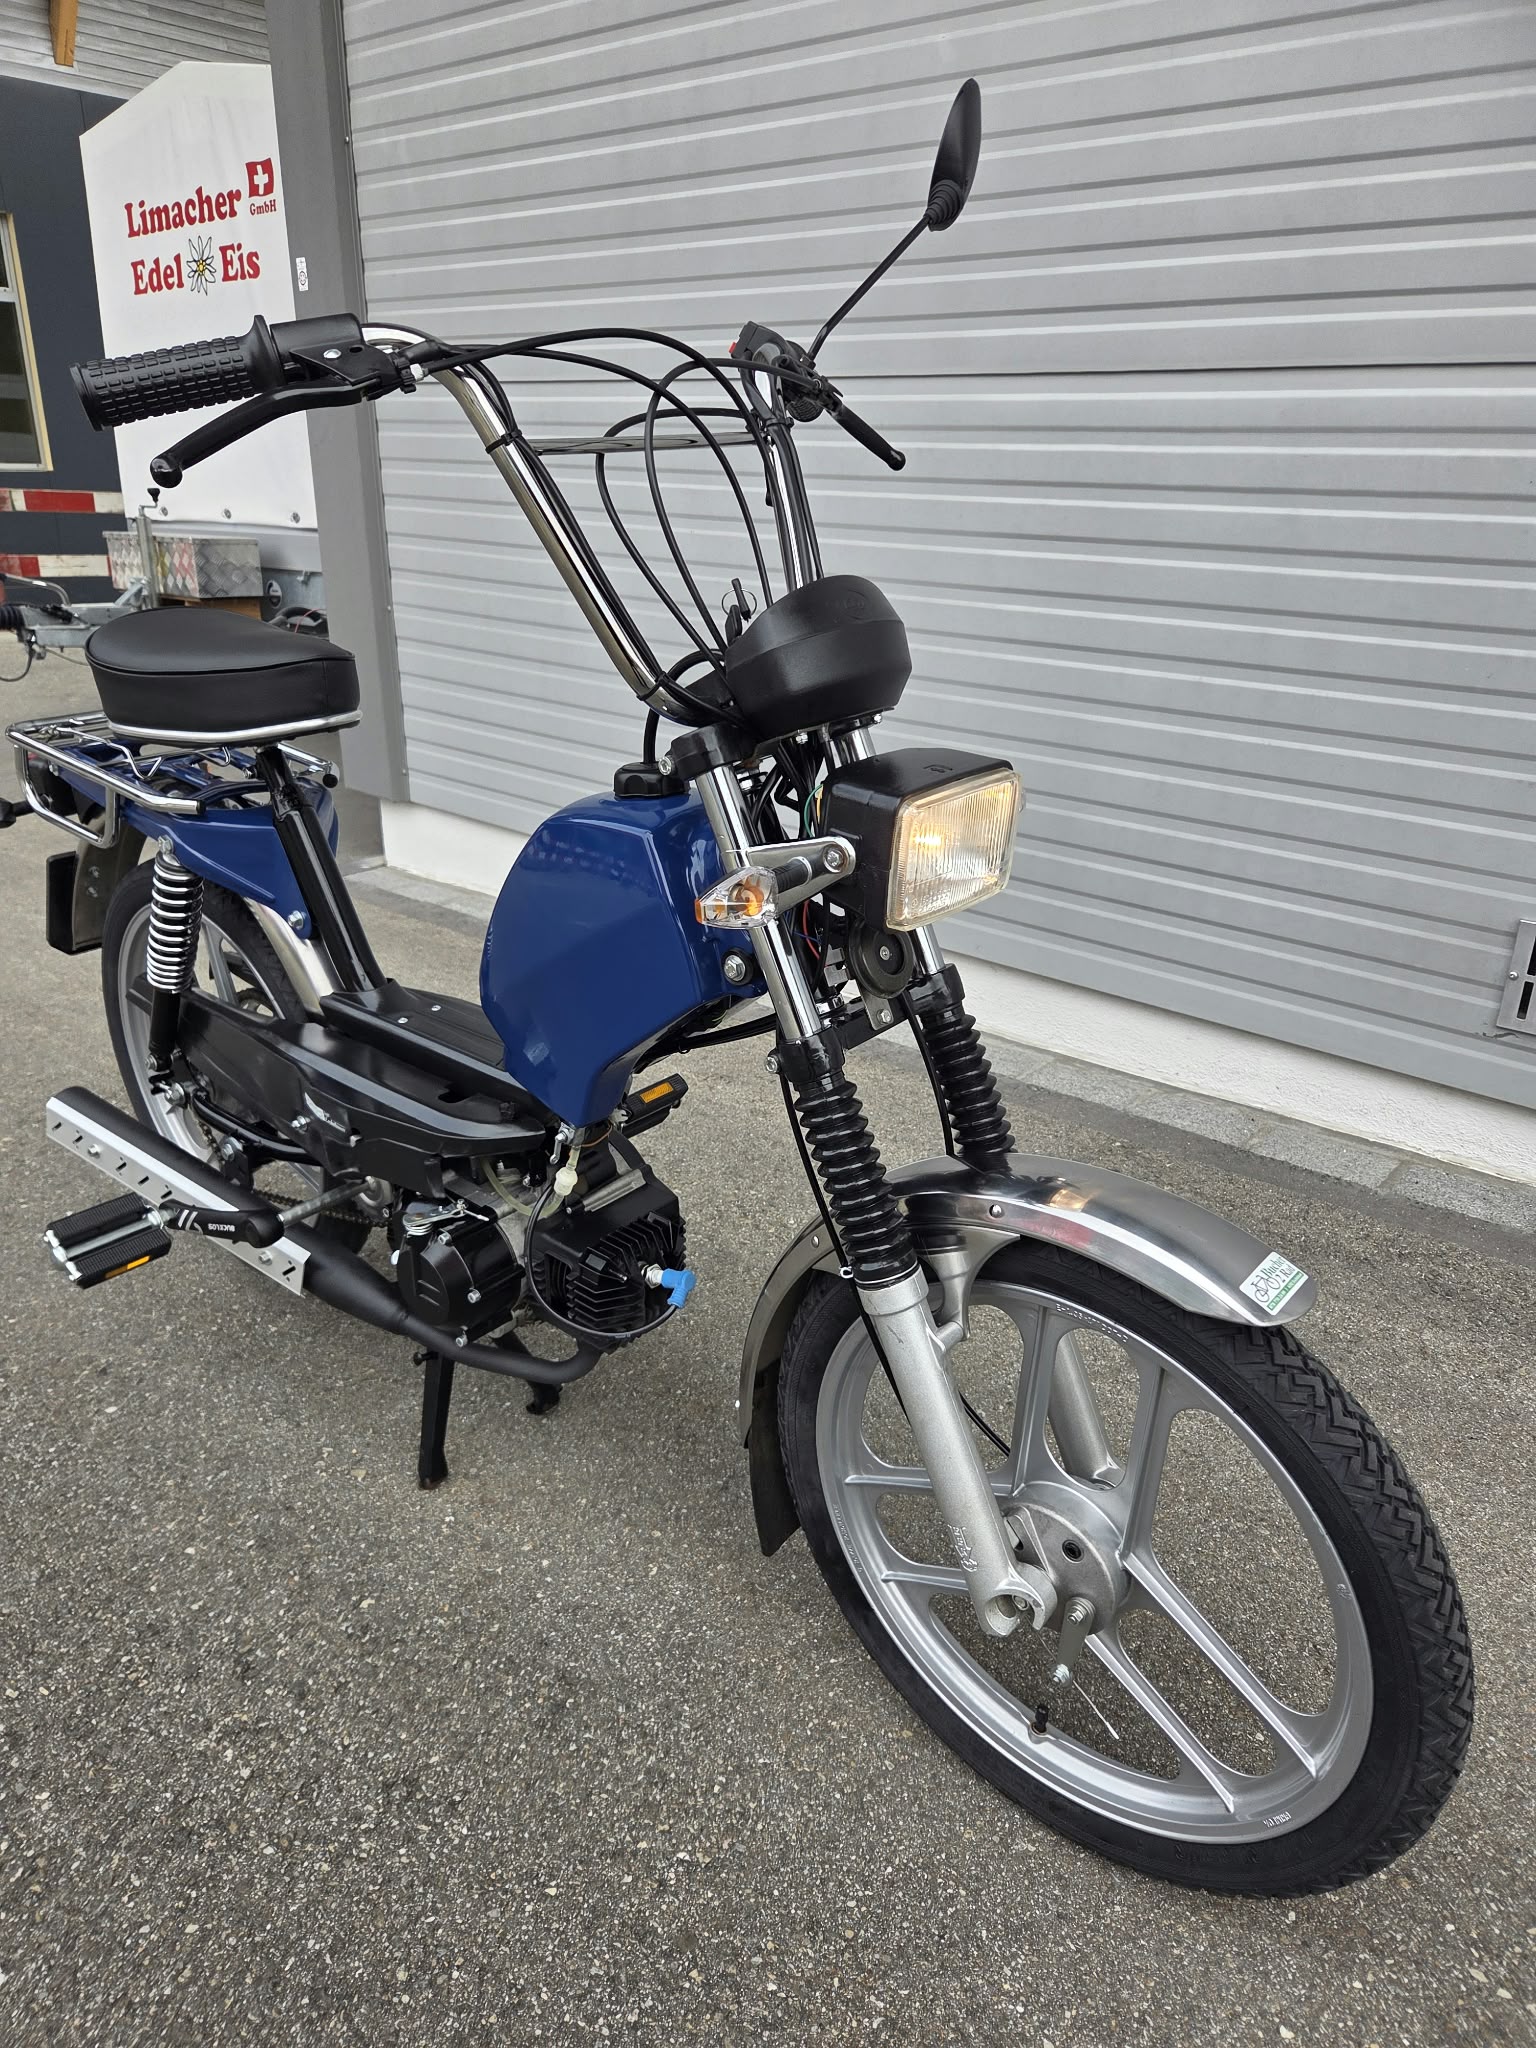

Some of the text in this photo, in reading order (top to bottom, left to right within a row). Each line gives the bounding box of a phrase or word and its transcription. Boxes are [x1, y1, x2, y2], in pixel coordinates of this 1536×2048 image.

[124, 186, 277, 238] Limacher GmbH
[130, 253, 184, 296] Edel
[219, 243, 261, 282] Eis
[1260, 1256, 1286, 1279] Bucher
[1275, 1274, 1286, 1283] 2
